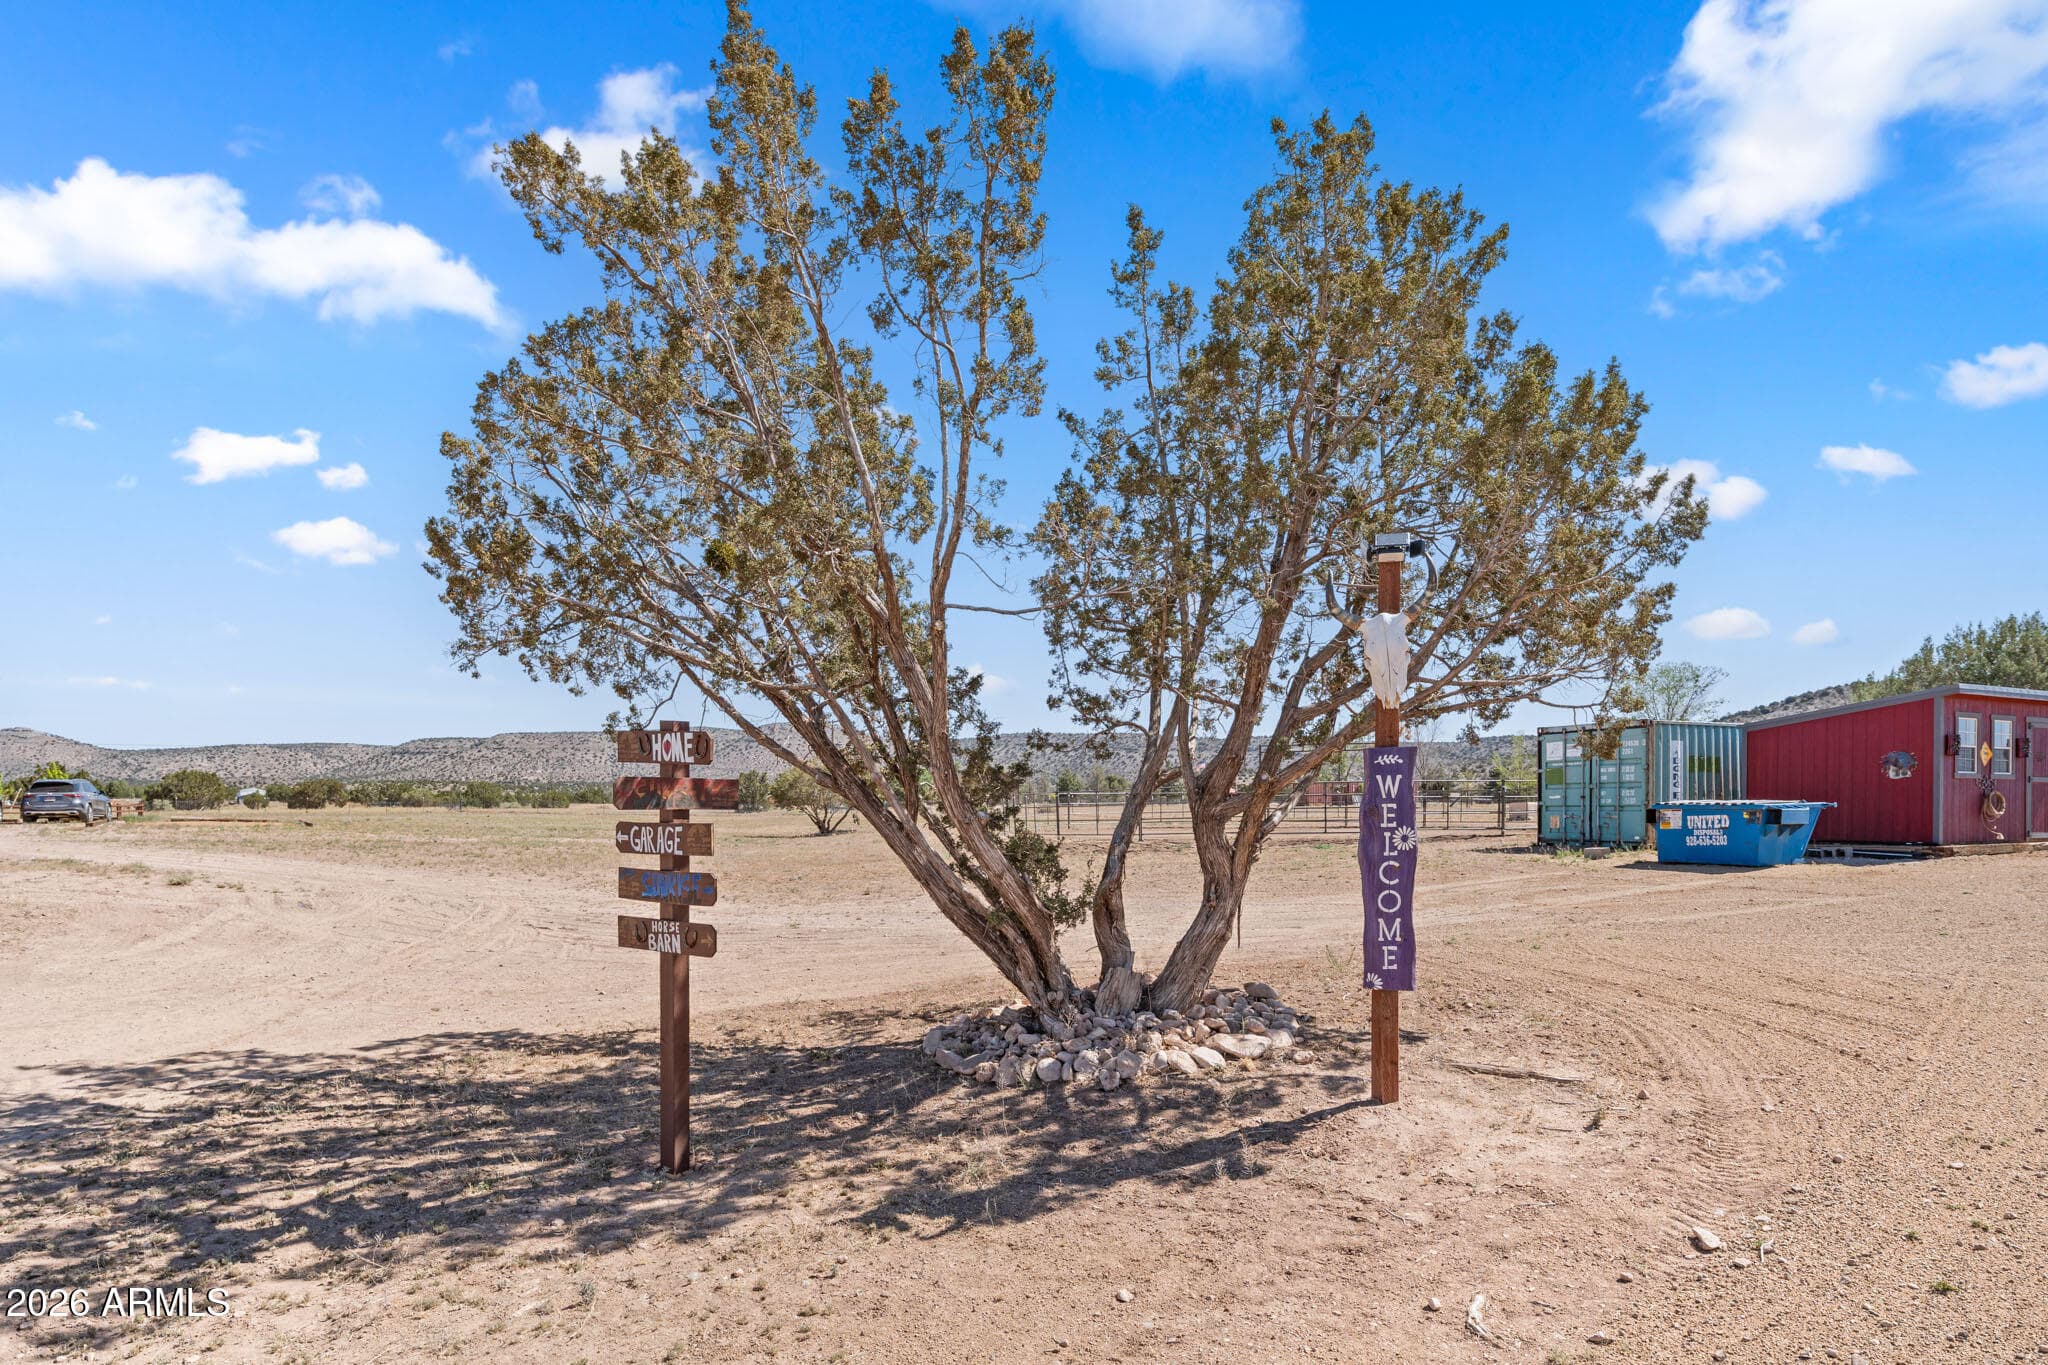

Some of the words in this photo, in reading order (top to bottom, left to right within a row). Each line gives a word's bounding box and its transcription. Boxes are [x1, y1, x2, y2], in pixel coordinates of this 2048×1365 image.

[652, 732, 694, 763] HOME
[1686, 814, 1730, 830] UNITED
[630, 826, 683, 855] GARAGE
[1376, 774, 1402, 970] WELCOME
[651, 920, 680, 933] HORSE
[648, 933, 681, 954] BARN
